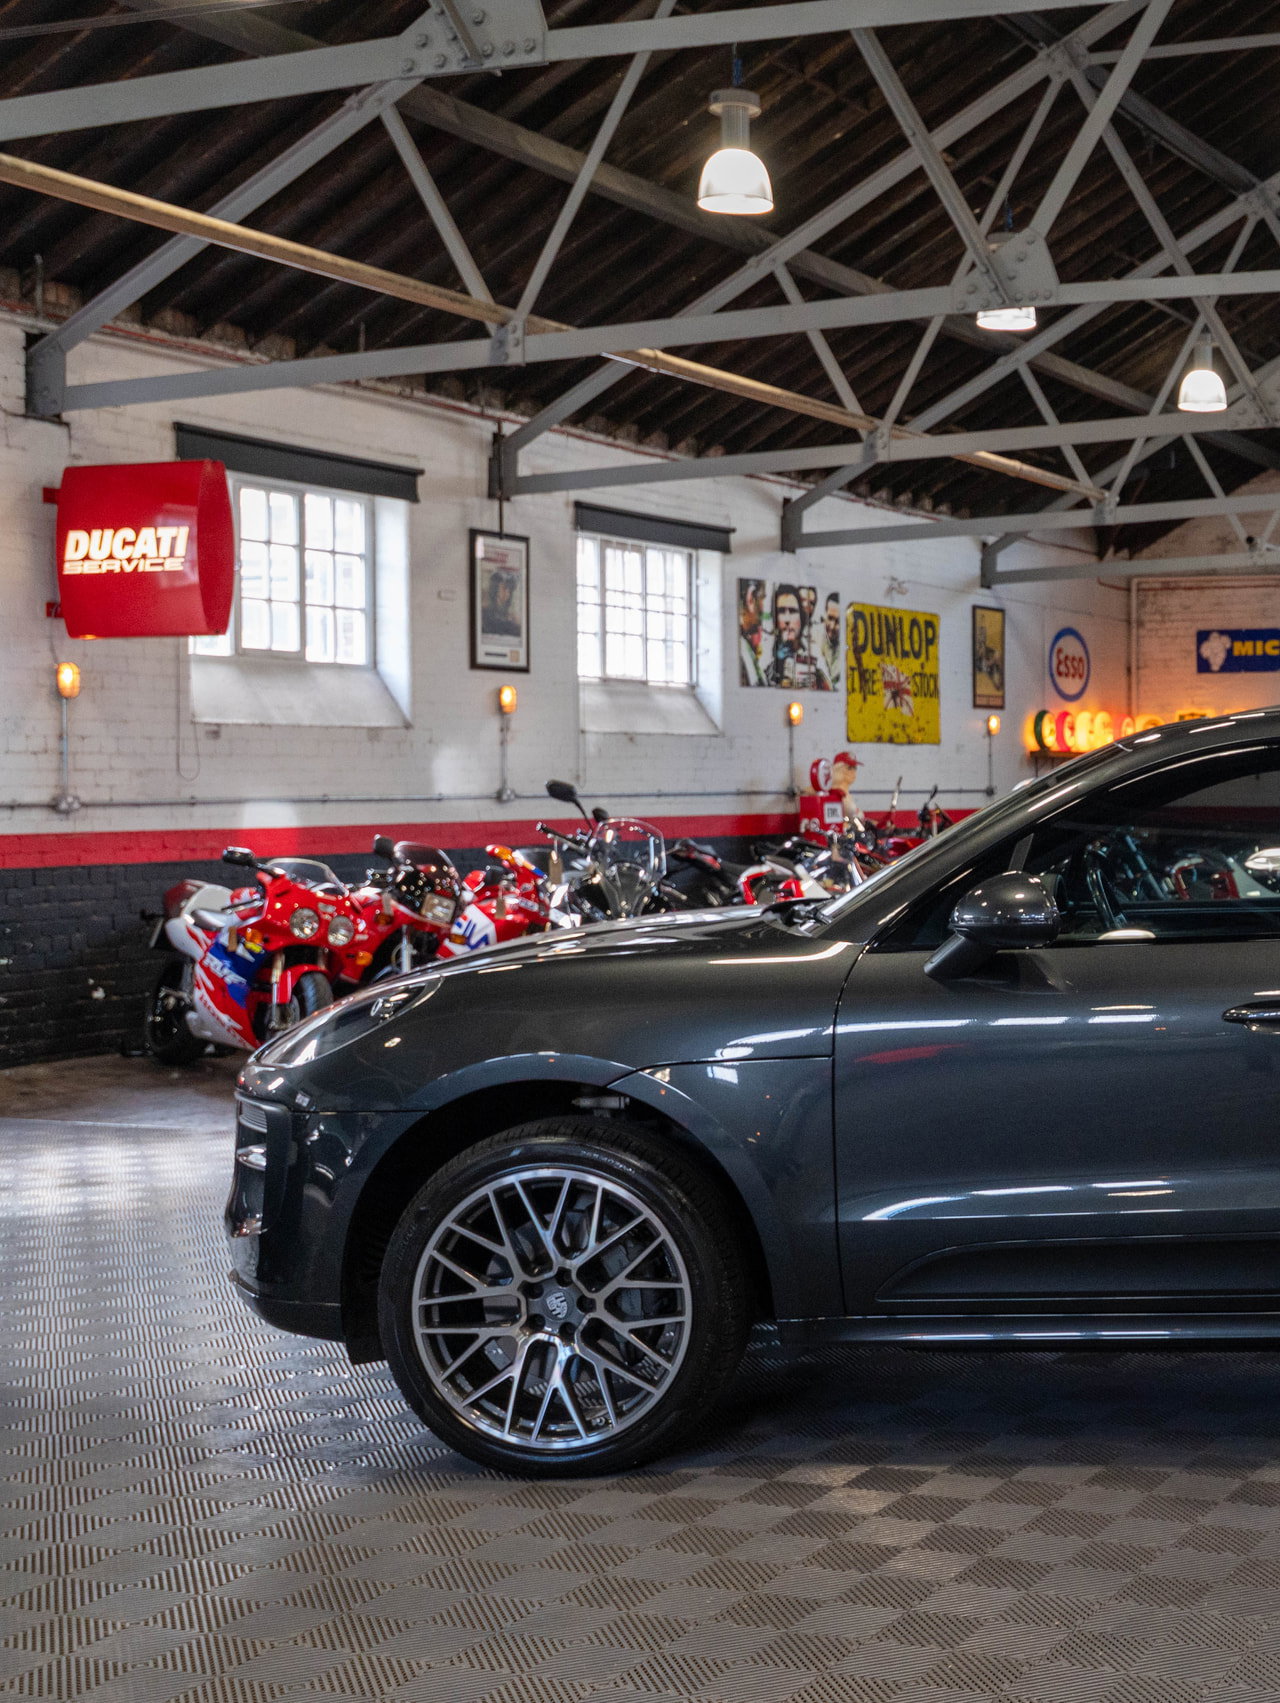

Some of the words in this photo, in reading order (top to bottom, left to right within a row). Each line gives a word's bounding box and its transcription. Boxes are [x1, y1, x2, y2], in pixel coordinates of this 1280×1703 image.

[64, 526, 190, 561] DUCATI
[62, 557, 185, 575] SERVICE
[853, 611, 936, 661] DUNLOP
